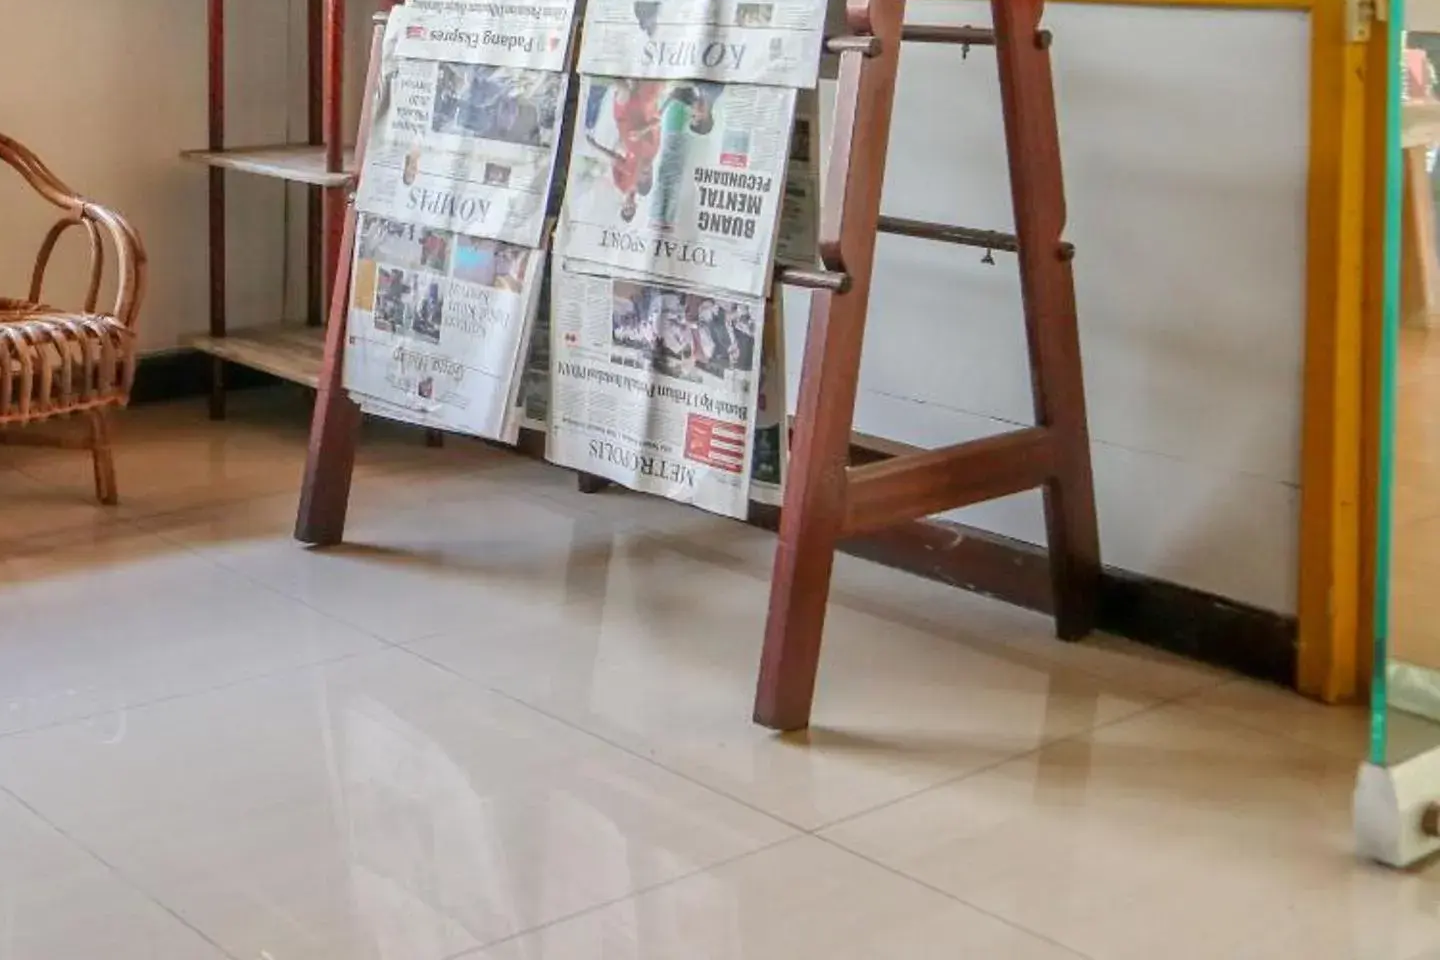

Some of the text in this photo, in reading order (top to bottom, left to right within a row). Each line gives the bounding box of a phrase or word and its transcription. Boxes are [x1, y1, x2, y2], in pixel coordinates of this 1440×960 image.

[430, 28, 480, 48] Ekspres
[483, 31, 534, 52] Padang
[640, 41, 747, 70] KOMPAS
[694, 168, 772, 192] PECUNDANG
[405, 187, 491, 223] KOMPAS
[698, 187, 763, 214] MENTAL
[697, 211, 755, 239] BUANG
[598, 230, 716, 267] TOTAL SPORT
[430, 357, 465, 382] Gaya
[658, 385, 691, 406] Triliun
[588, 439, 696, 487] METROPOLIS
